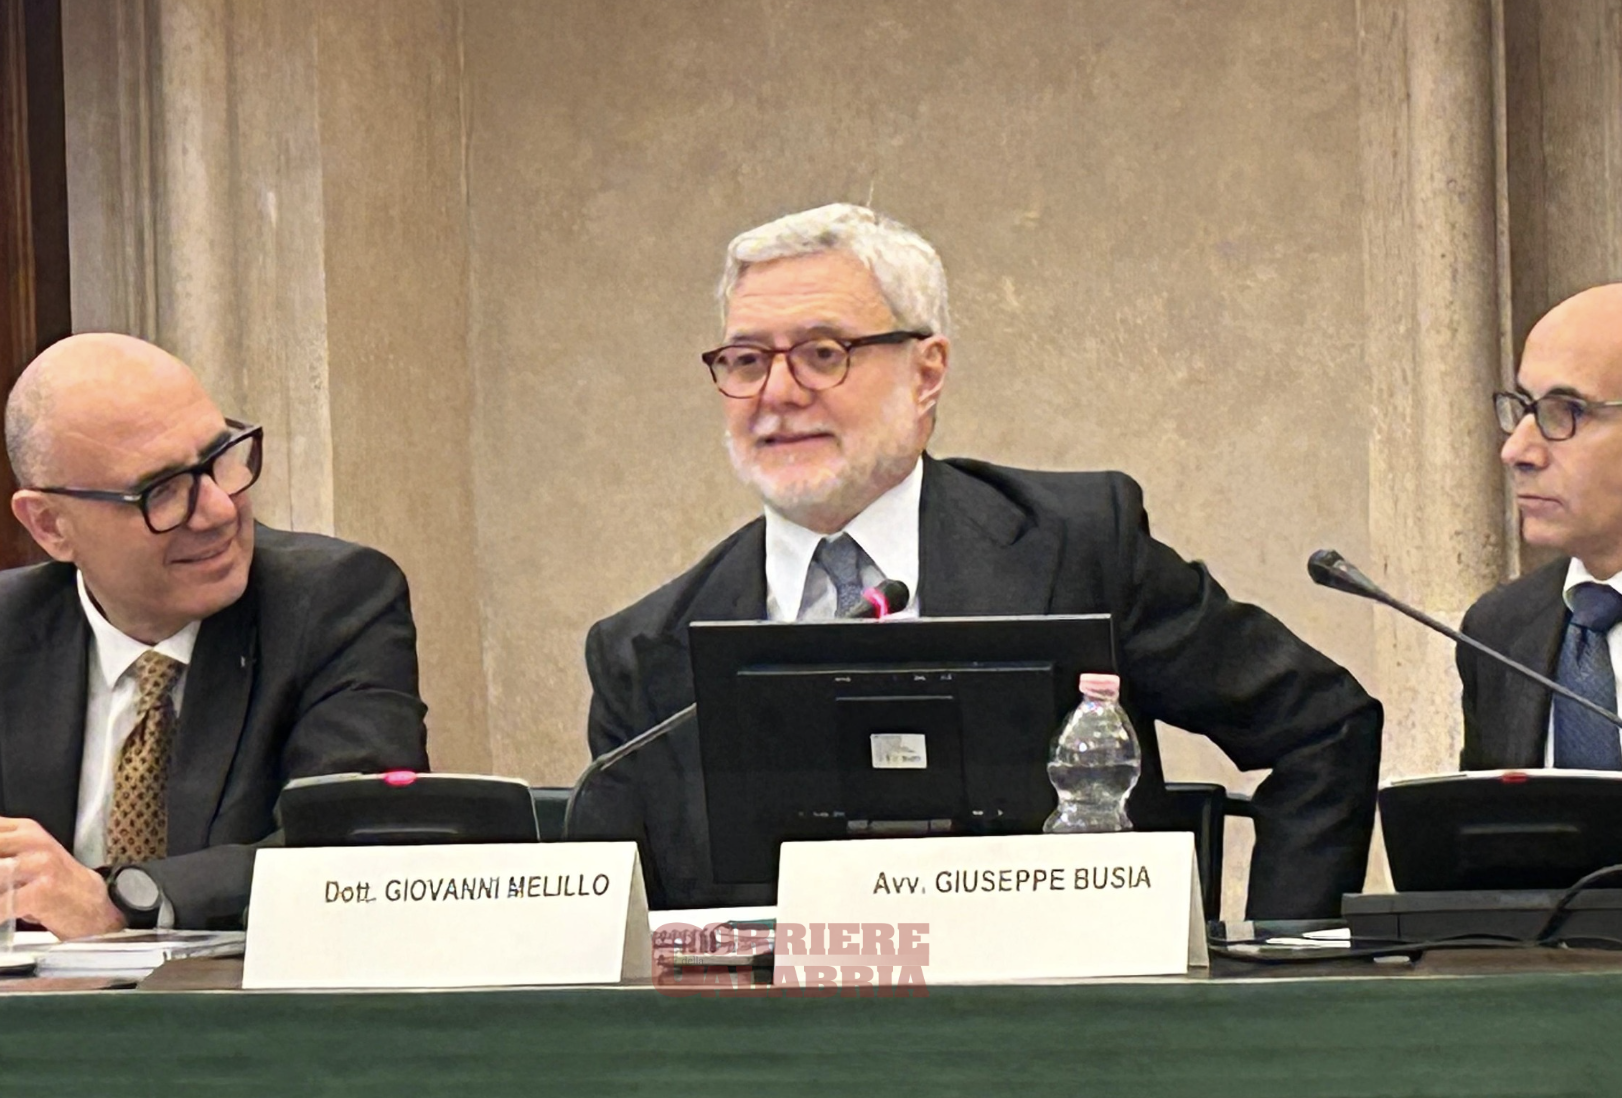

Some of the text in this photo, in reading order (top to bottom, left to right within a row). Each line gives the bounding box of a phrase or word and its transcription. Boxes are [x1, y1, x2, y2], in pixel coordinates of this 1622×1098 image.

[324, 873, 610, 904] Dott. GIOVANNI MELILLO
[872, 865, 1152, 895] Avv. GIUSEPPE BUSIA
